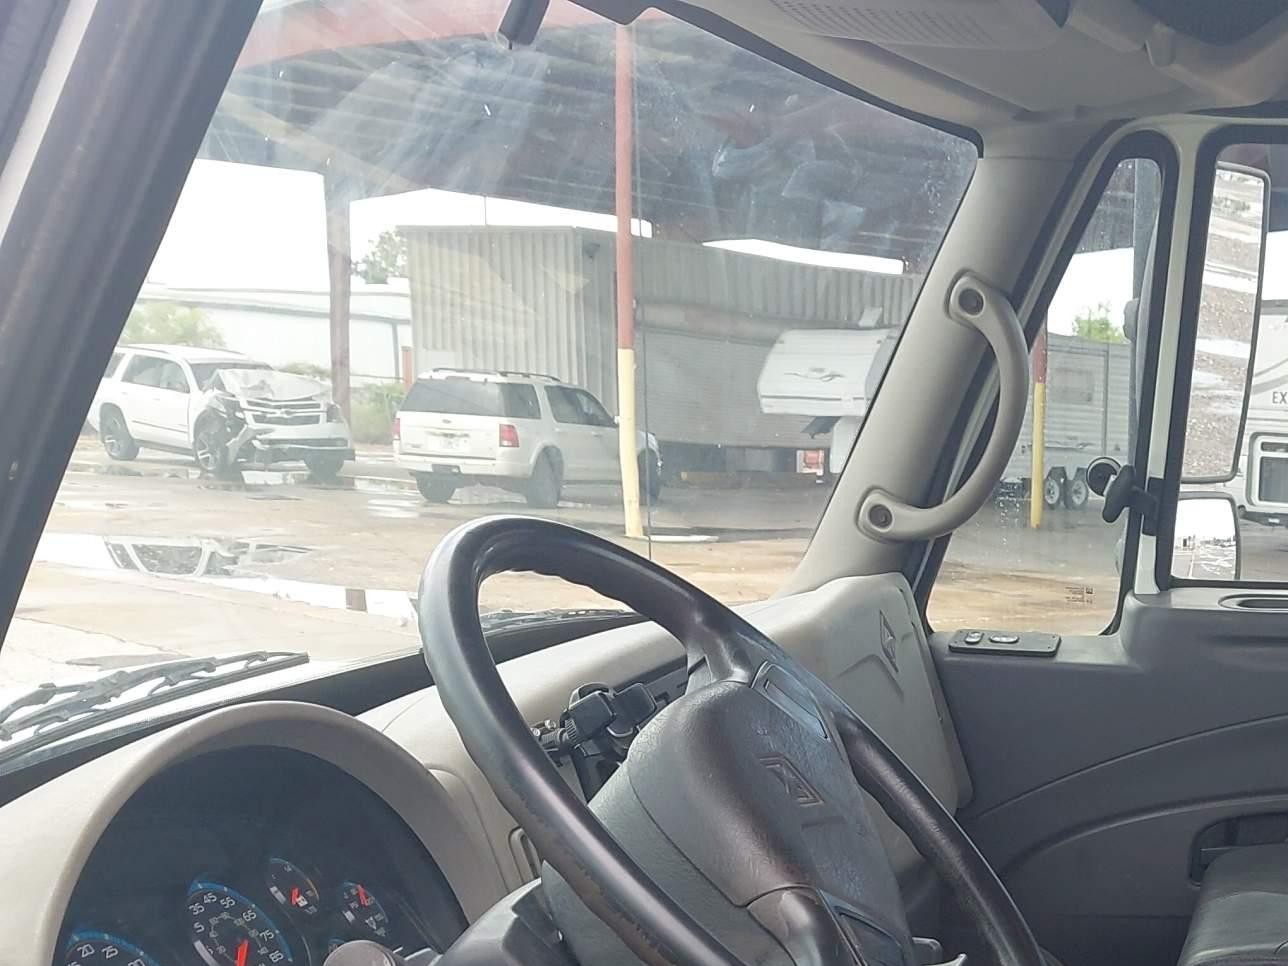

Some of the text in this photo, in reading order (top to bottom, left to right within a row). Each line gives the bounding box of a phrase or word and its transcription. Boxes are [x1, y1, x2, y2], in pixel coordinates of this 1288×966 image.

[203, 892, 217, 904] 45
[220, 896, 236, 909] 55
[189, 902, 205, 916] 35
[242, 909, 257, 922] 65
[259, 929, 275, 942] 75
[77, 943, 95, 958] 20
[101, 945, 119, 959] 25
